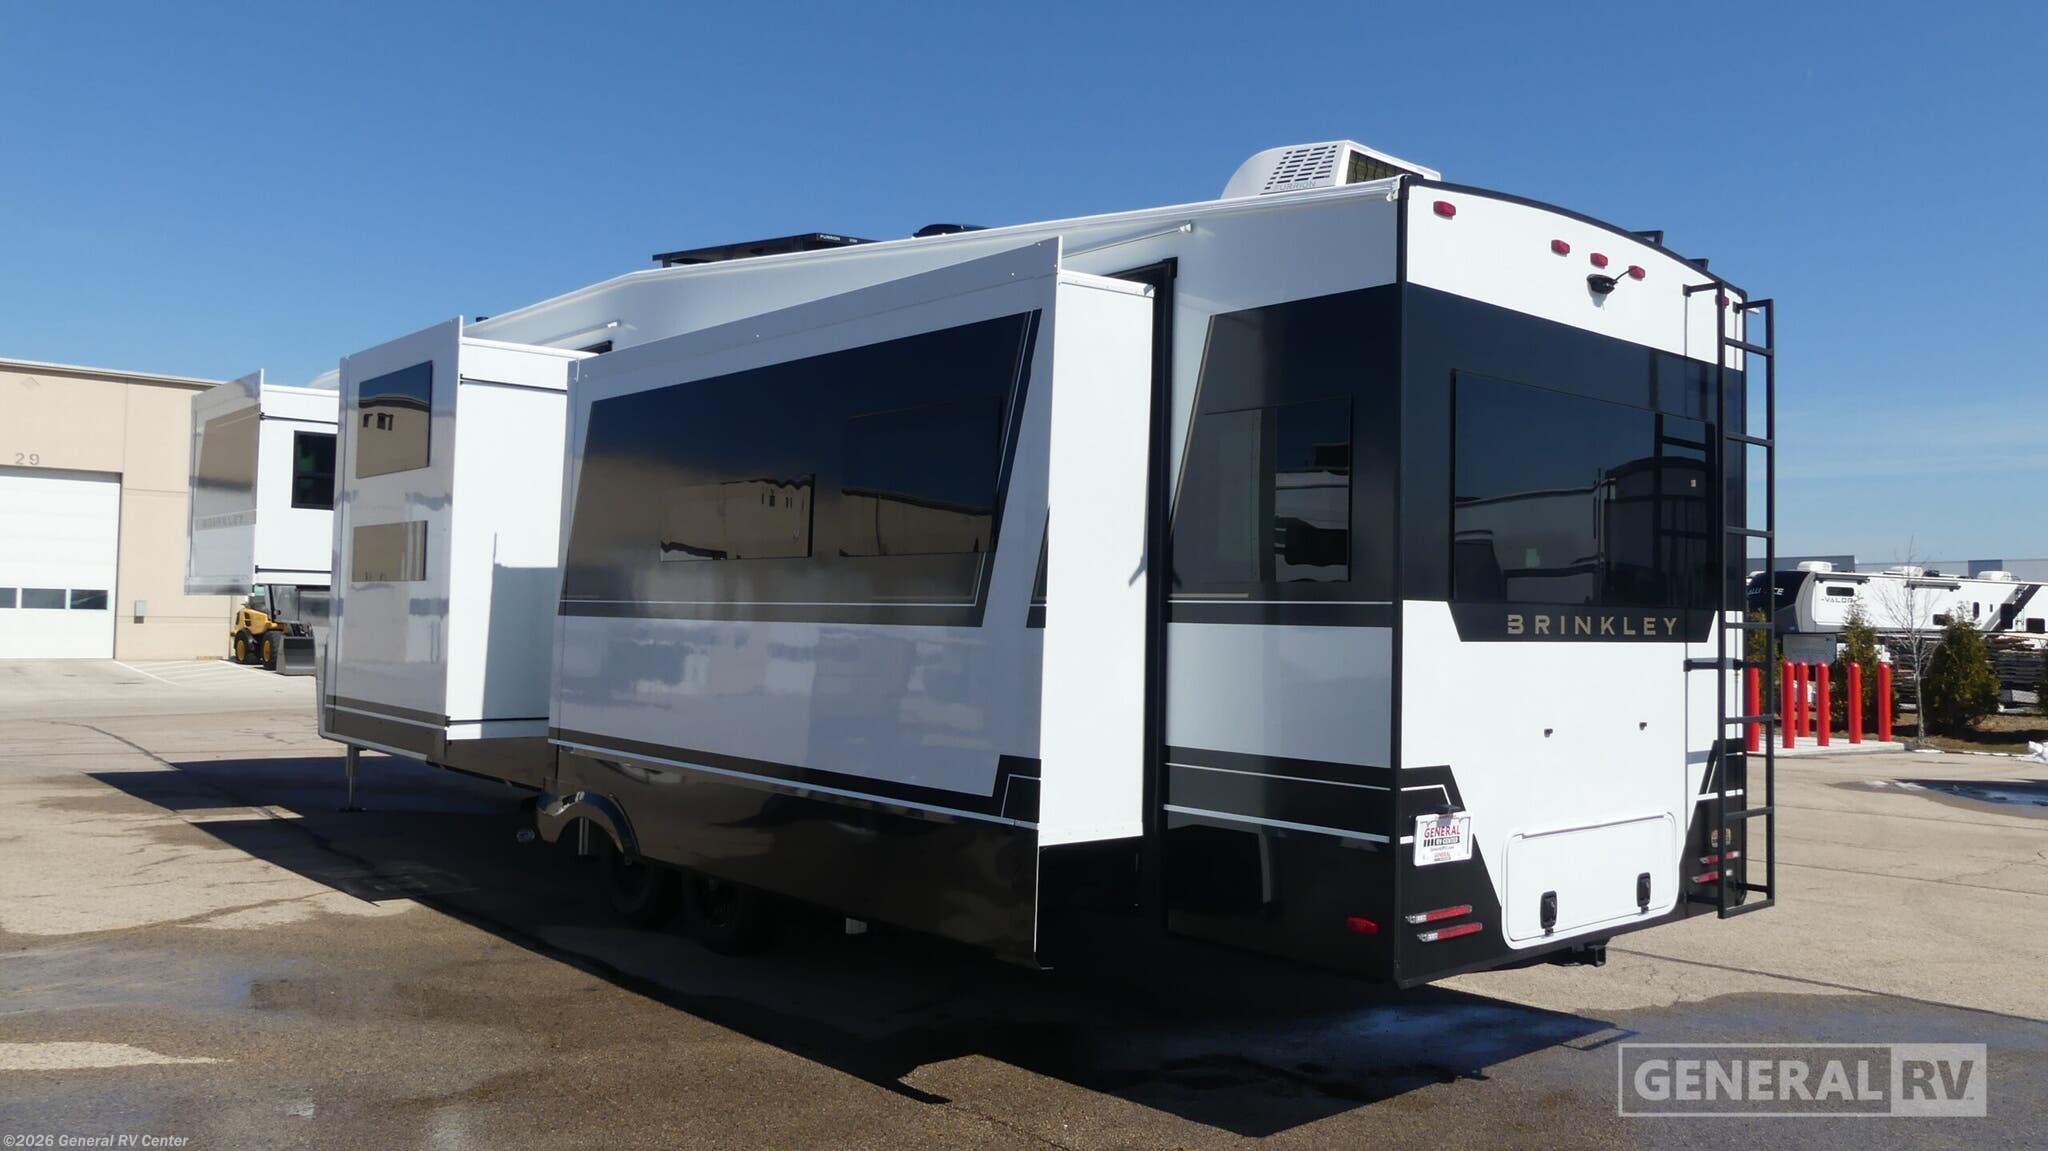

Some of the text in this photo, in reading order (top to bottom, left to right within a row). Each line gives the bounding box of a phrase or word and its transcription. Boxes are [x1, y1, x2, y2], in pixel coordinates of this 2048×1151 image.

[15, 452, 40, 466] 29
[1506, 614, 1678, 636] BRINKLEY
[1424, 825, 1461, 839] GENERAL
